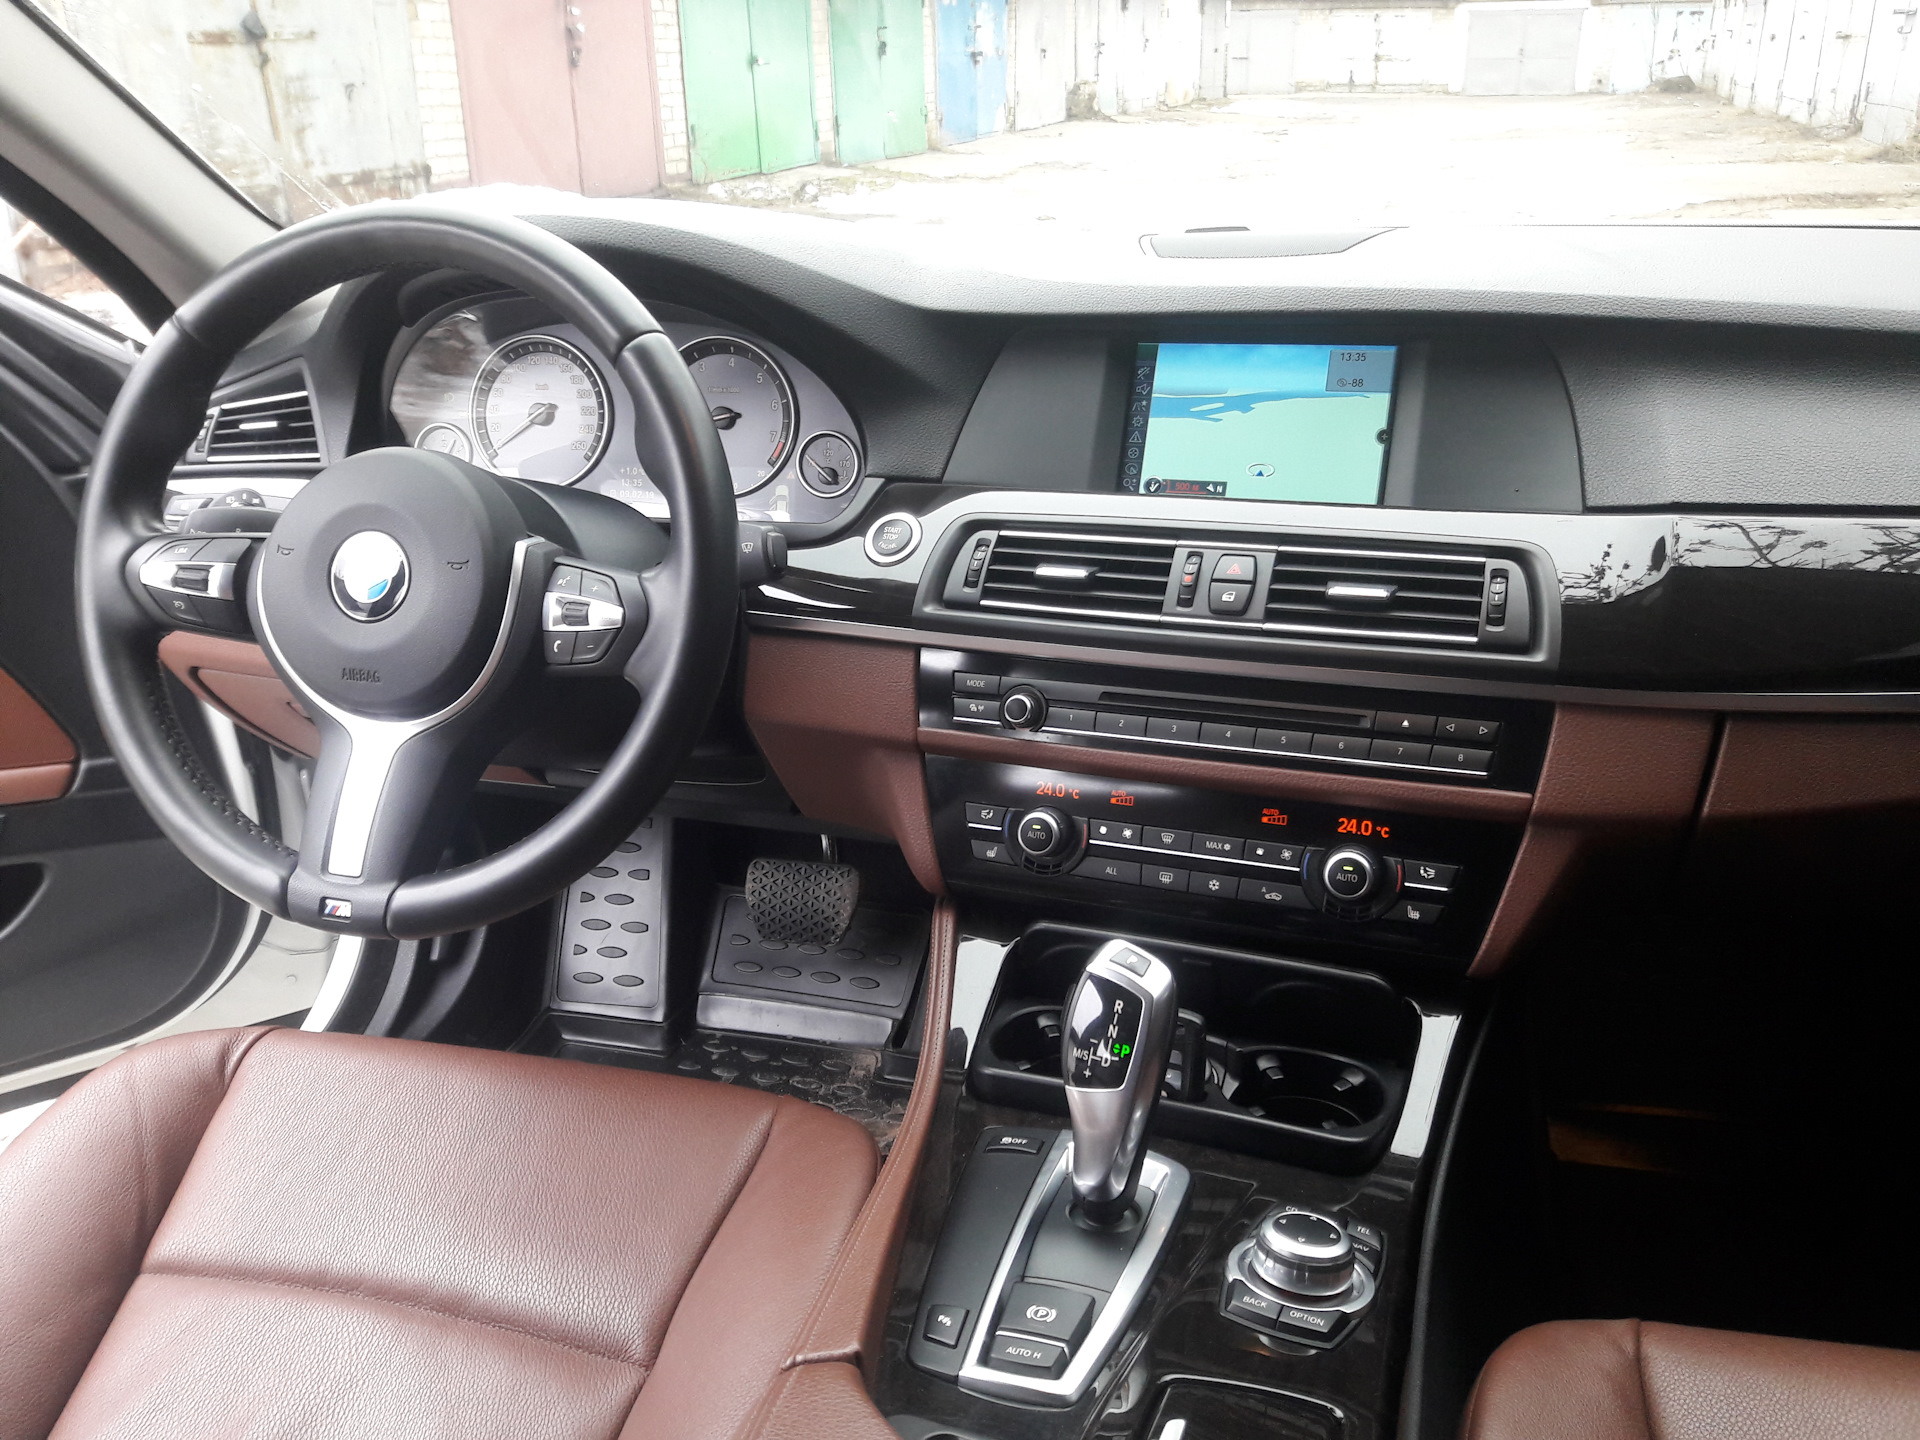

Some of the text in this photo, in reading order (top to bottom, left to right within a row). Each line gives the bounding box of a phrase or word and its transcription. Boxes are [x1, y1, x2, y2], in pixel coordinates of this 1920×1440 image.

[527, 356, 541, 365] 120
[544, 356, 558, 365] 140
[1340, 352, 1367, 362] 13:35
[699, 362, 706, 372] 3
[728, 357, 735, 368] 4
[560, 364, 573, 373] 160
[570, 375, 585, 385] 180
[756, 372, 763, 384] 5
[576, 389, 592, 399] 200
[771, 400, 779, 411] 6
[580, 406, 596, 417] 220
[579, 424, 594, 434] 240
[770, 431, 777, 443] 7
[571, 441, 587, 451] 260
[823, 449, 834, 457] 120
[839, 459, 851, 468] 170
[621, 478, 642, 487] 13:35
[1175, 482, 1190, 491] 500
[1216, 485, 1223, 493] N
[883, 526, 903, 534] START
[341, 667, 381, 683] AIRBAG
[966, 679, 986, 688] MODE
[1170, 725, 1177, 733] 3
[1280, 736, 1287, 744] 5
[1338, 742, 1345, 750] 6
[1457, 754, 1464, 762] 8
[1036, 781, 1066, 798] 24.0
[1111, 789, 1127, 797] AUTO
[1262, 808, 1279, 816] AUTO
[1337, 817, 1373, 836] 24.0
[1027, 830, 1046, 840] AUTO
[1205, 840, 1223, 850] MAX
[1105, 866, 1118, 876] ALL
[1336, 872, 1358, 883] AUTO
[1126, 954, 1138, 964] P
[1113, 999, 1124, 1014] R
[1107, 1023, 1119, 1039] N
[1072, 1046, 1089, 1061] M/S
[1120, 1044, 1131, 1058] P
[1100, 1054, 1111, 1068] D
[1011, 1137, 1028, 1145] OFF
[1356, 1226, 1371, 1236] TEL
[1242, 1295, 1268, 1308] BACK
[1036, 1308, 1047, 1319] P
[1289, 1310, 1325, 1327] OPTION
[1005, 1346, 1042, 1360] AUTO H
